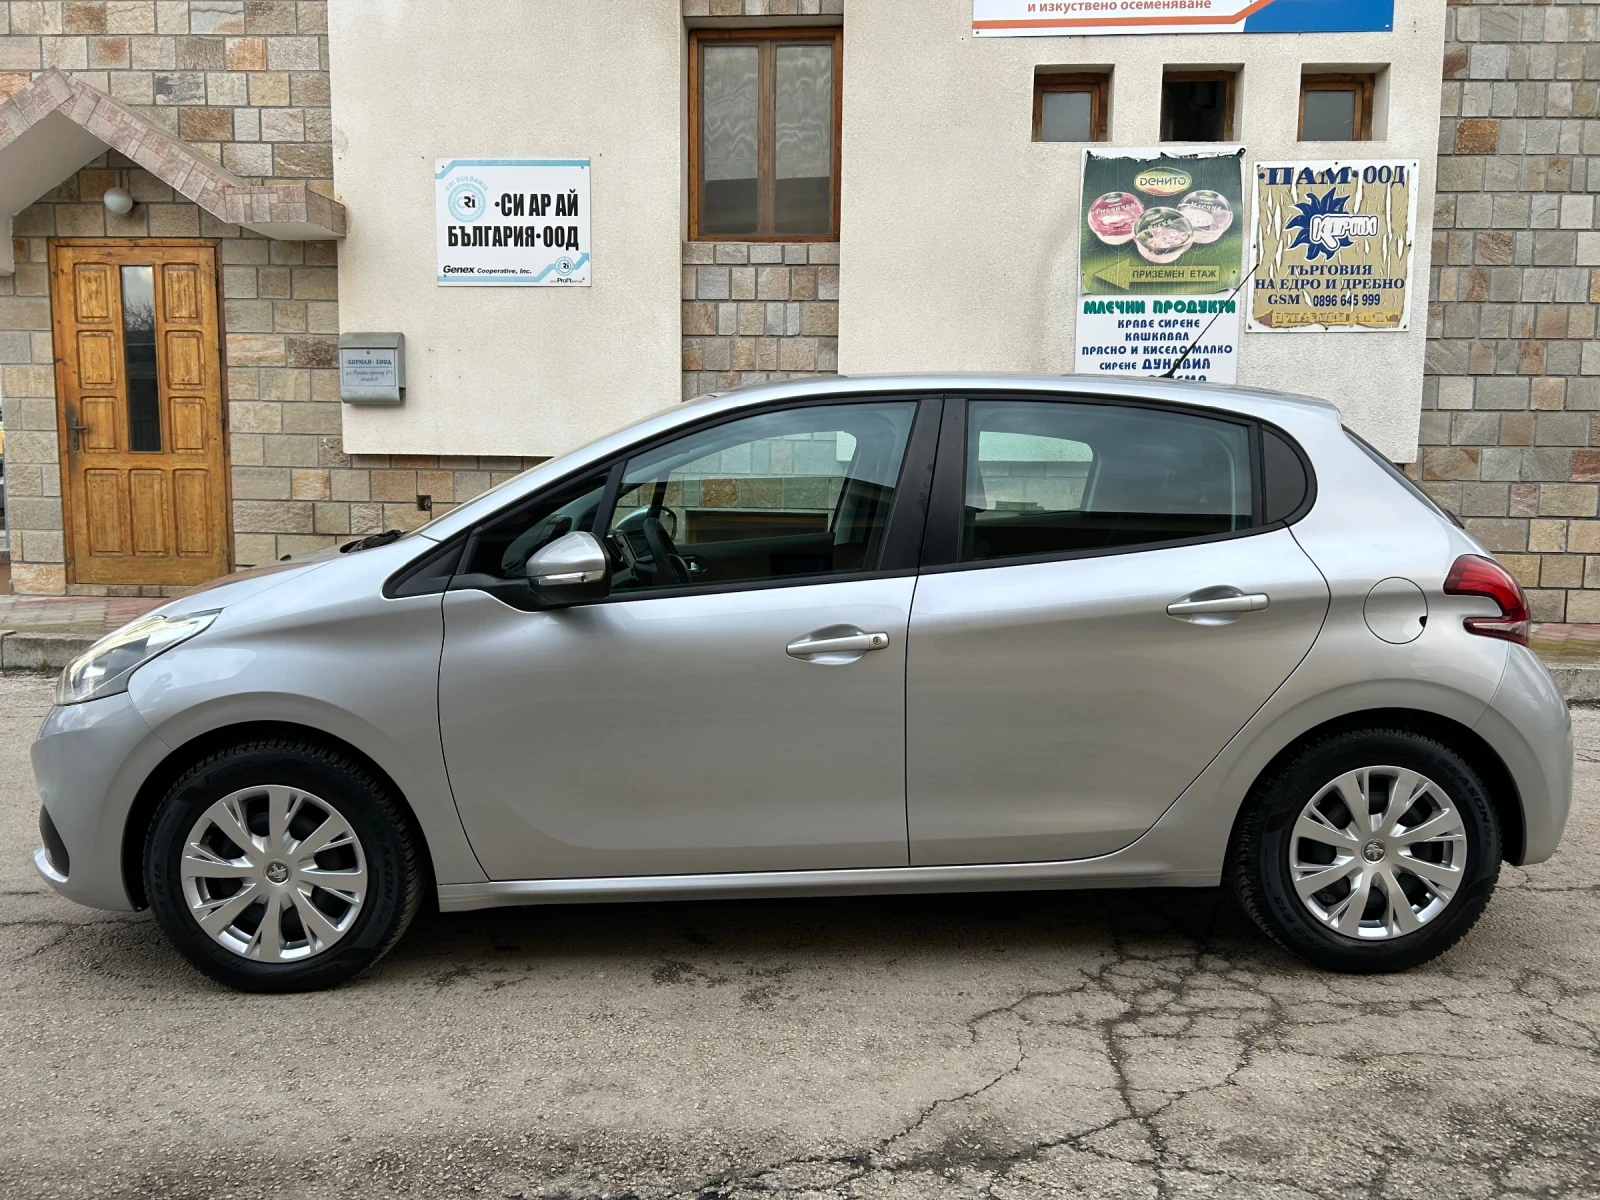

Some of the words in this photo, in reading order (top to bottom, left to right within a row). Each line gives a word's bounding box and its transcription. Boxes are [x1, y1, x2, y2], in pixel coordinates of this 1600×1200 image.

[1028, 3, 1036, 12] и
[1040, 2, 1117, 14] изкуствено
[1120, 0, 1212, 10] осеменяване
[1266, 166, 1352, 185] ПАМ
[1363, 165, 1405, 188] ООД
[456, 176, 488, 191] BULGARIA
[529, 194, 551, 216] АР
[555, 189, 578, 216] АЙ
[544, 226, 579, 250] ООД
[443, 265, 475, 274] Genex
[477, 267, 518, 275] Cooperative,
[1132, 270, 1185, 278] ПРИЗЕМЕН
[1289, 265, 1372, 275] ТЪРГОВИЯ
[1255, 279, 1275, 289] НА
[1280, 279, 1321, 291] ЕДРО
[1325, 279, 1337, 289] И
[1341, 279, 1405, 291] ДРЕБНО
[1268, 295, 1300, 305] GSM
[1313, 295, 1337, 306] 0896
[1362, 294, 1380, 305] 999
[1083, 300, 1146, 315] МЛЕЧНИ
[1152, 299, 1236, 314] ПРОДУКТИ
[1117, 319, 1155, 329] КРАВЕ
[1158, 319, 1200, 328] СИРЕНЕ
[1125, 332, 1190, 342] КАШКАВАЛ
[1082, 345, 1127, 355] ПРЯСНО
[1131, 345, 1138, 355] И
[1143, 345, 1188, 355] КИСЕЛО
[1192, 345, 1233, 354] МЛЯКО
[1099, 362, 1137, 370] СИРЕНЕ
[1142, 358, 1211, 370] ДУНАВИЛ
